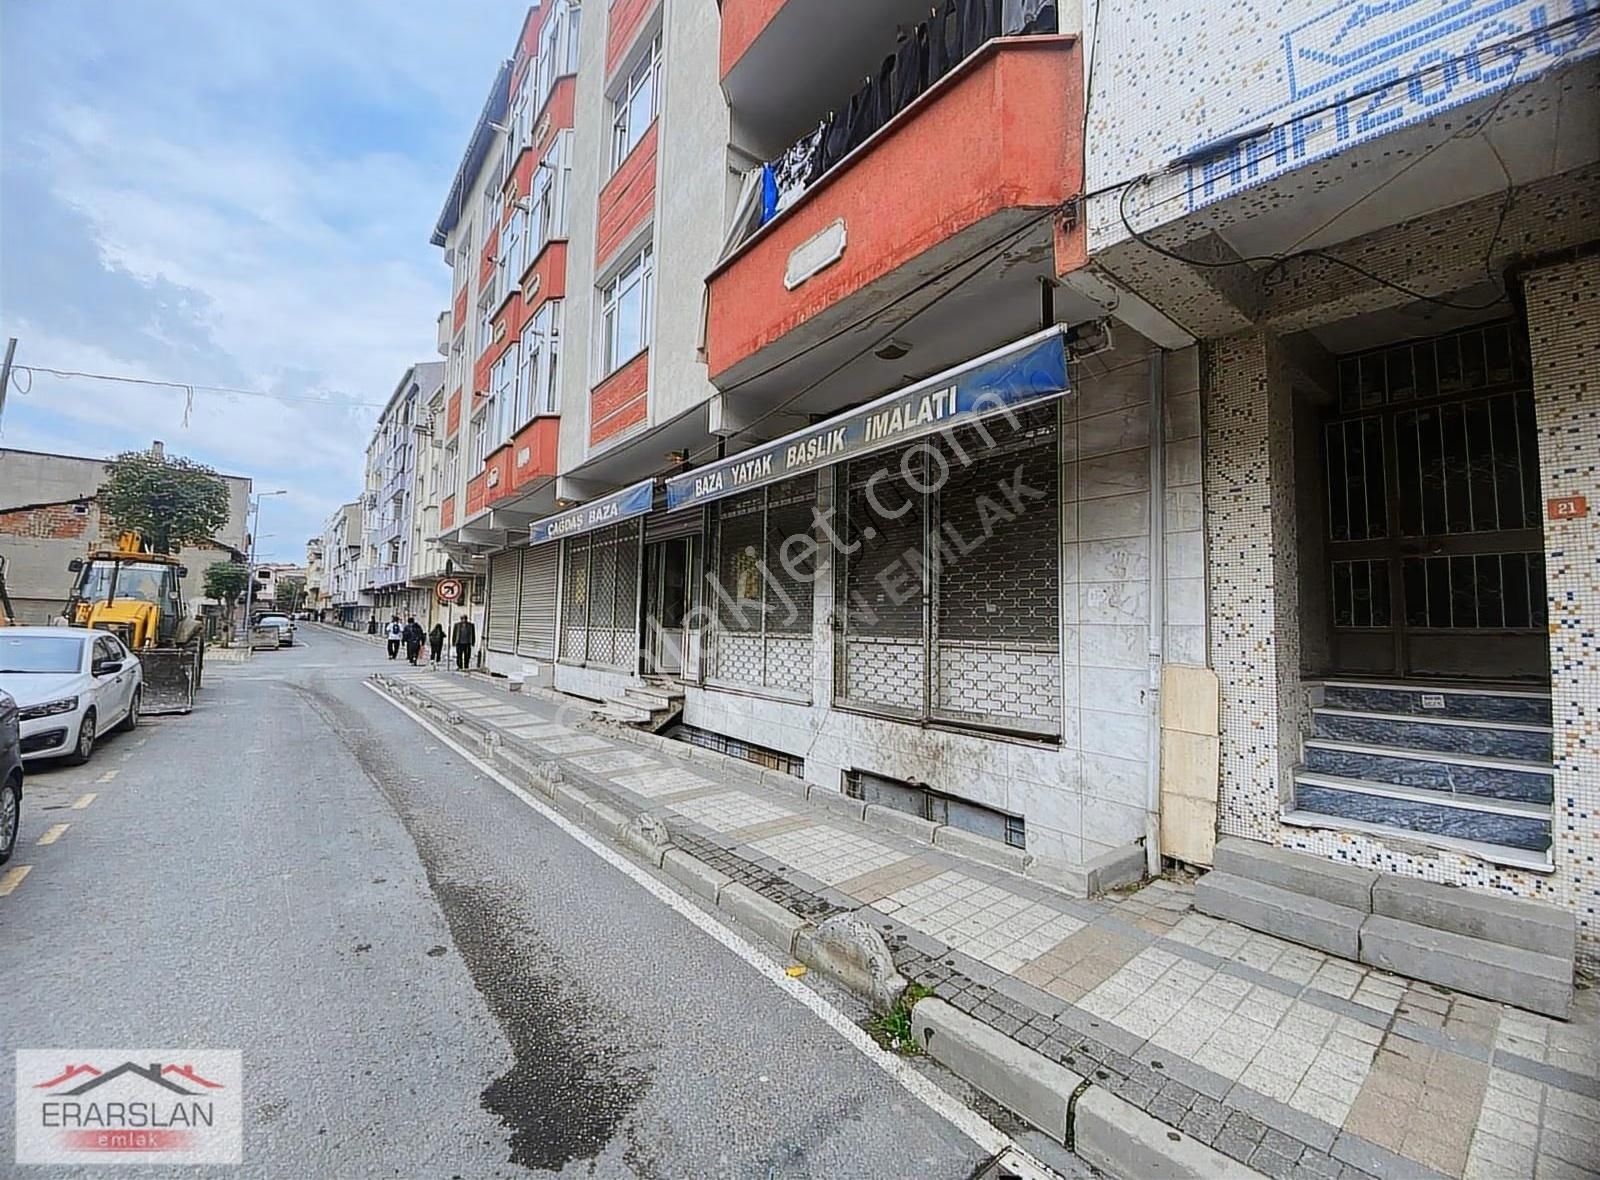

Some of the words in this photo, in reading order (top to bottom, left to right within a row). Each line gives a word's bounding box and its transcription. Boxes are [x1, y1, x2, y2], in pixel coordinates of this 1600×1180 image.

[695, 472, 723, 497] BAZA
[731, 454, 773, 485] YATAK
[786, 427, 847, 466] BAŞLIK
[589, 502, 618, 523] BAZA
[1558, 502, 1577, 515] 21
